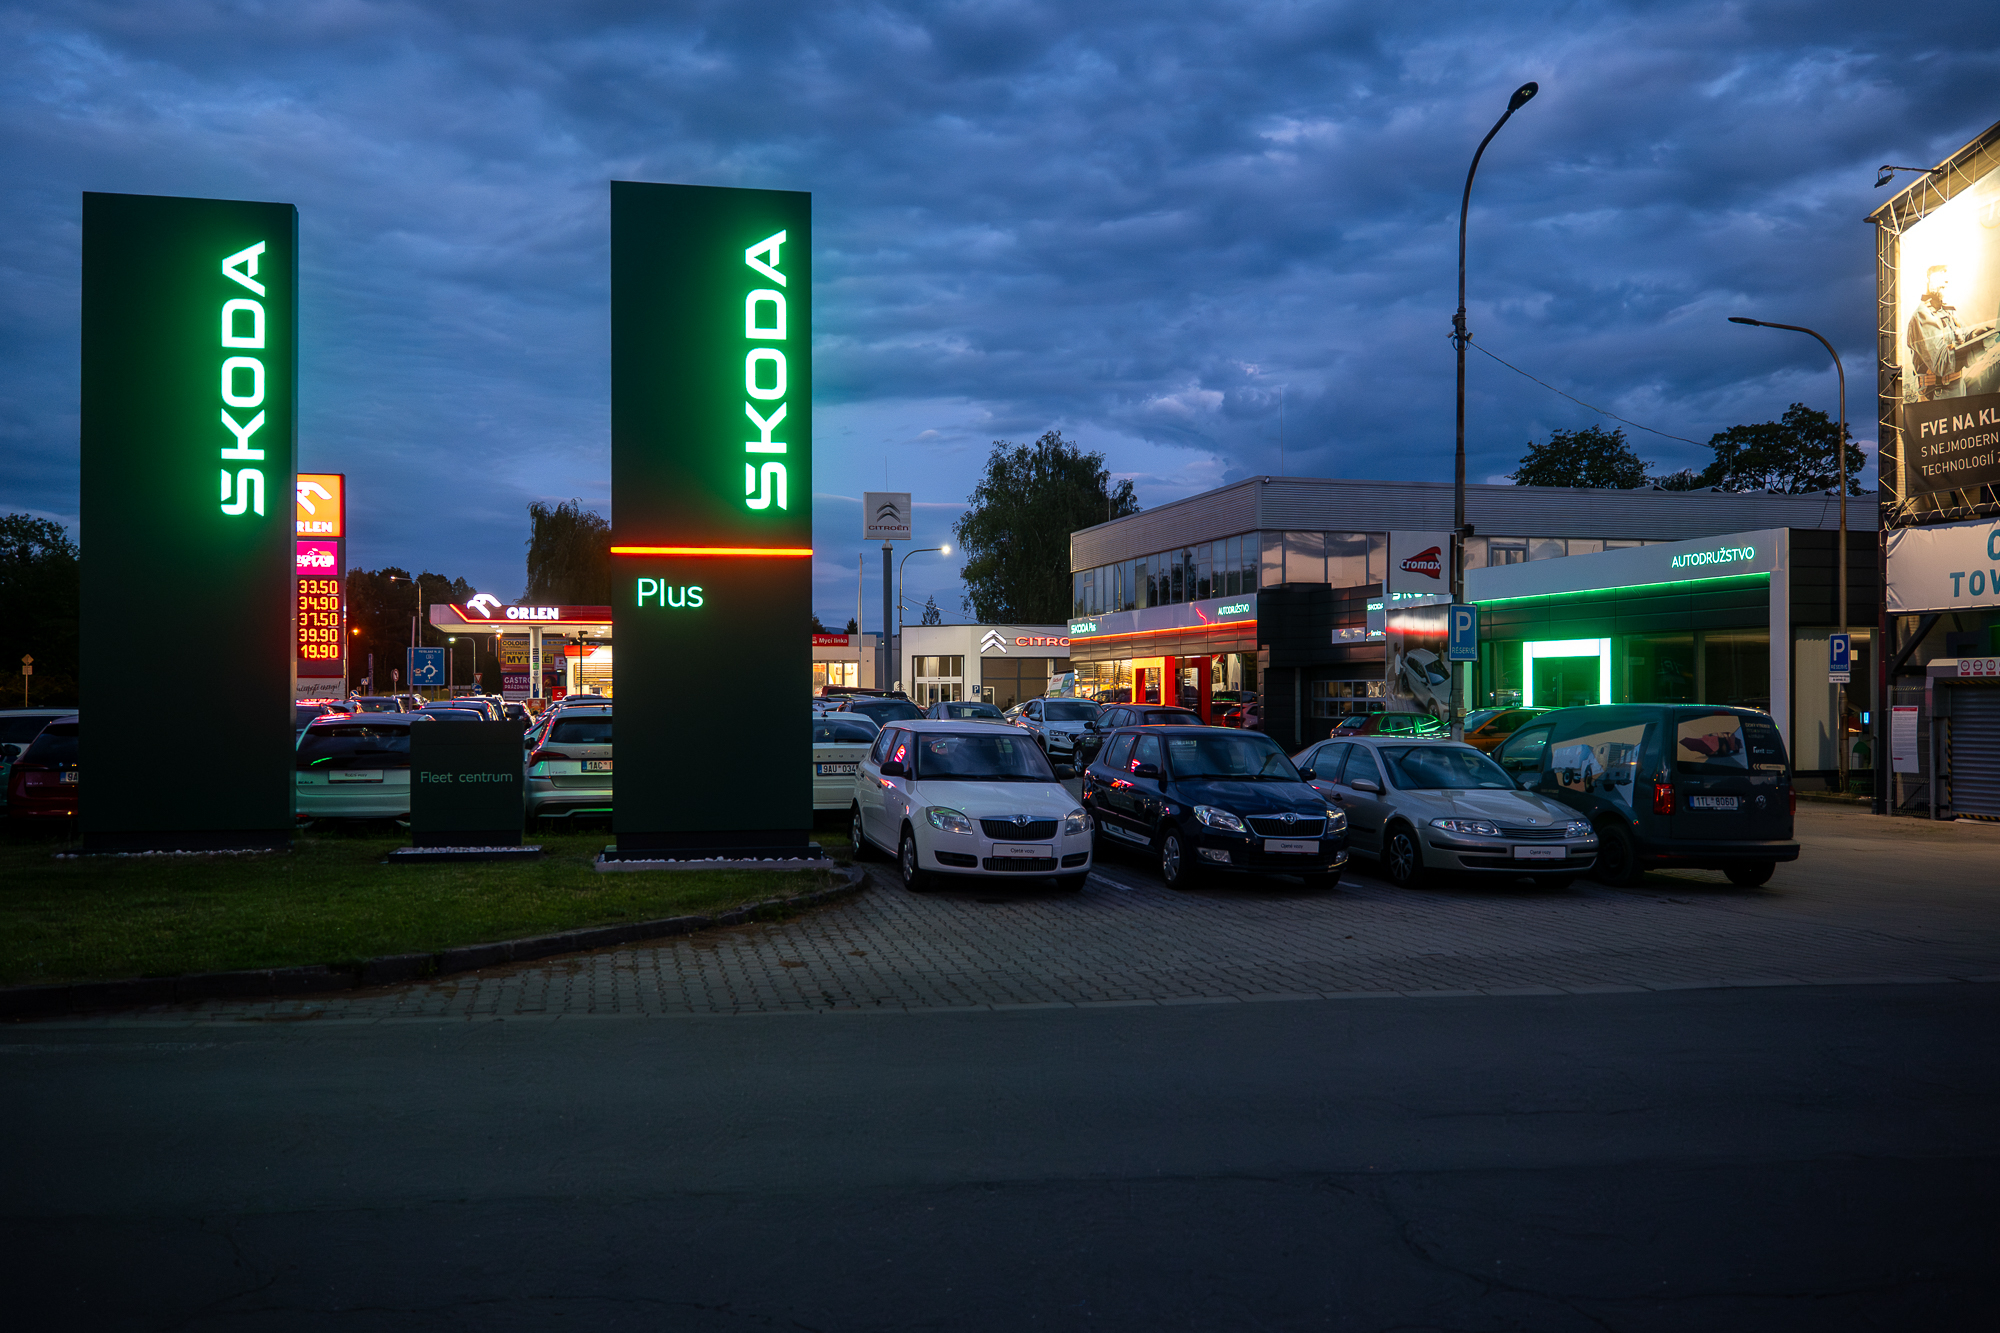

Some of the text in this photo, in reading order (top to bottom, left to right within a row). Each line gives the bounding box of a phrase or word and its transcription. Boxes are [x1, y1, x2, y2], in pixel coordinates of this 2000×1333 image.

[1920, 417, 1948, 438] FVE
[1952, 412, 1975, 431] NA
[1921, 431, 1999, 457] S NEJMODERN
[1922, 450, 1994, 476] TECHNOLOGIÍ
[297, 521, 332, 533] RLEN
[1671, 546, 1755, 568] AUTODRUŽSTVO
[1400, 559, 1441, 570] Cromax
[298, 579, 339, 594] 33.50
[637, 578, 704, 607] Plus
[298, 596, 339, 610] 34.90
[298, 612, 339, 626] 37.50
[506, 606, 559, 620] ORLEN
[1456, 611, 1471, 643] P
[298, 628, 339, 643] 39.90
[819, 637, 833, 645] Mycí
[1015, 636, 1070, 646] CITRO
[301, 644, 339, 659] 19.90
[1833, 639, 1845, 661] P
[823, 765, 837, 773] 9AU
[420, 772, 513, 783] Fleet centrum
[1696, 797, 1711, 806] 1TL
